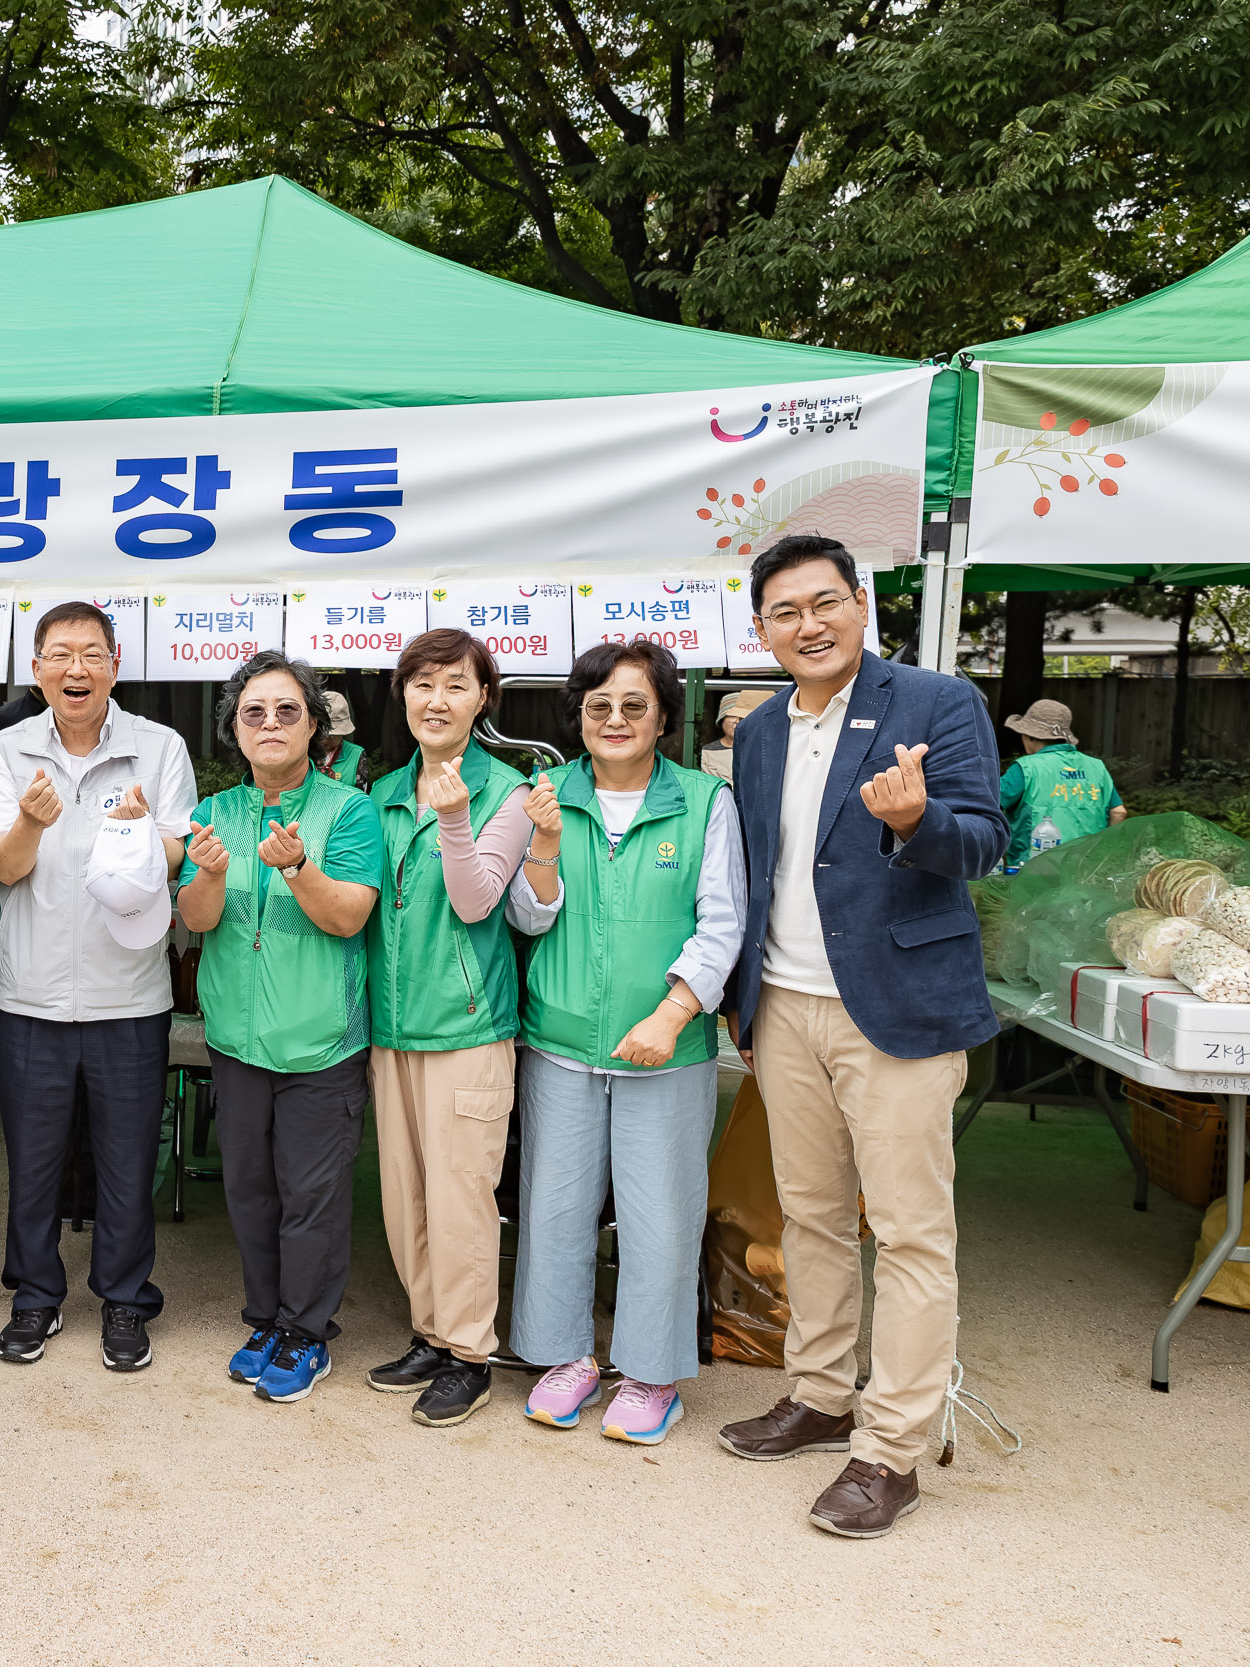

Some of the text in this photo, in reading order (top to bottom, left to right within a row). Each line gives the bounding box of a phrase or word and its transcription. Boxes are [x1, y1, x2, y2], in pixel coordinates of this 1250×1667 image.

[777, 407, 862, 435] 행복광진
[174, 611, 254, 632] 지리멸치
[324, 606, 387, 625] 들기름
[467, 605, 531, 626] 참기름
[603, 600, 691, 622] 모시송편
[170, 641, 258, 664] 10,000원
[310, 632, 402, 652] 13,000원
[486, 635, 548, 656] 000원
[654, 860, 679, 870] SMU
